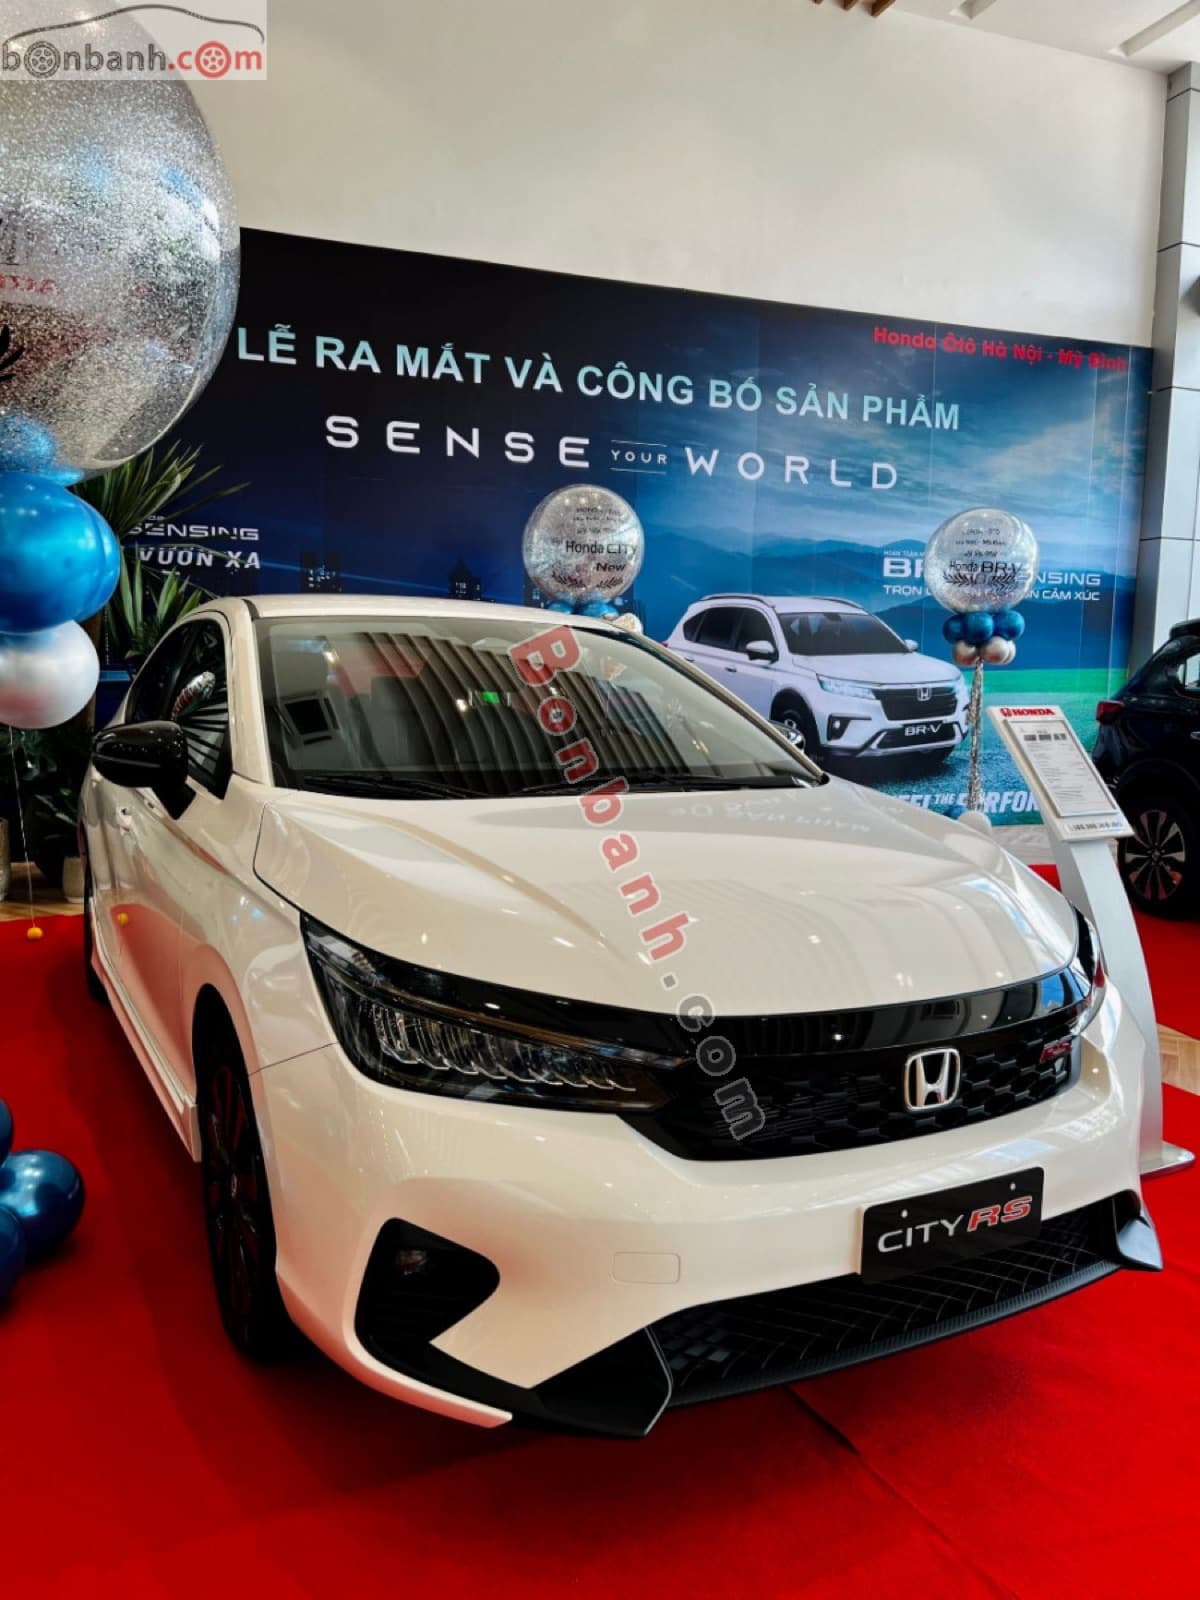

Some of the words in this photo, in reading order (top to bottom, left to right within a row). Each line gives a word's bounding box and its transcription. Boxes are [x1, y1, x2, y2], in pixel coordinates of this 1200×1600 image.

[873, 326, 937, 350] Honda
[981, 339, 1008, 359] Hà
[1012, 343, 1043, 365] Nội
[238, 323, 297, 365] LỄ
[315, 335, 381, 374] RA
[396, 342, 490, 384] MẮT
[504, 352, 563, 392] VÀ
[576, 361, 694, 405] CÔNG
[708, 376, 763, 412] BỐ
[775, 382, 849, 420] SẢN
[862, 393, 960, 430] PHẨM
[325, 414, 590, 468] SENSE
[610, 449, 668, 465] YOUR
[684, 446, 898, 489] WORLD
[225, 550, 260, 569] XA
[565, 540, 604, 554] Honda
[595, 562, 626, 573] New
[904, 723, 942, 737] BR-V
[878, 1213, 964, 1253] CITY
[966, 1195, 1033, 1232] RS
